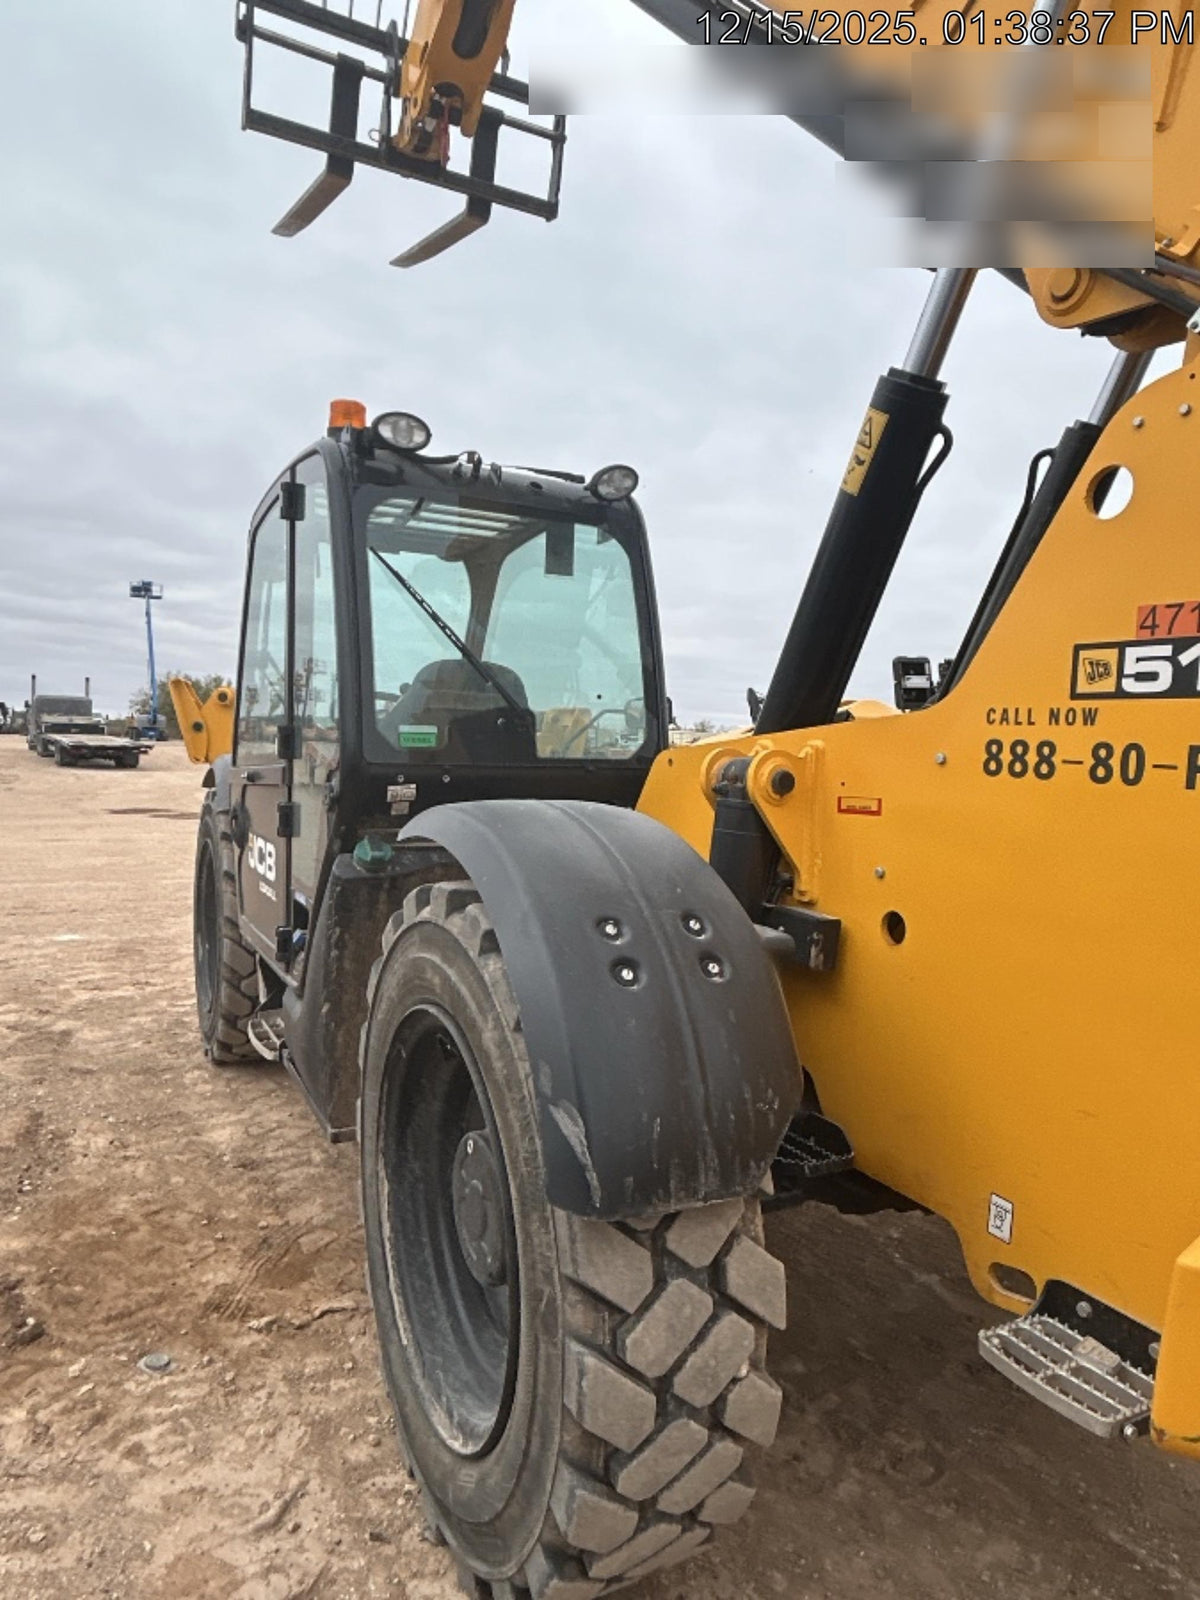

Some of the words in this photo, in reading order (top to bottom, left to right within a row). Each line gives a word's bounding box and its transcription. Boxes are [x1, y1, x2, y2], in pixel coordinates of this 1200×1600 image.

[1084, 659, 1113, 684] JCB
[986, 707, 1036, 726] CALL
[1048, 707, 1099, 726] NOW
